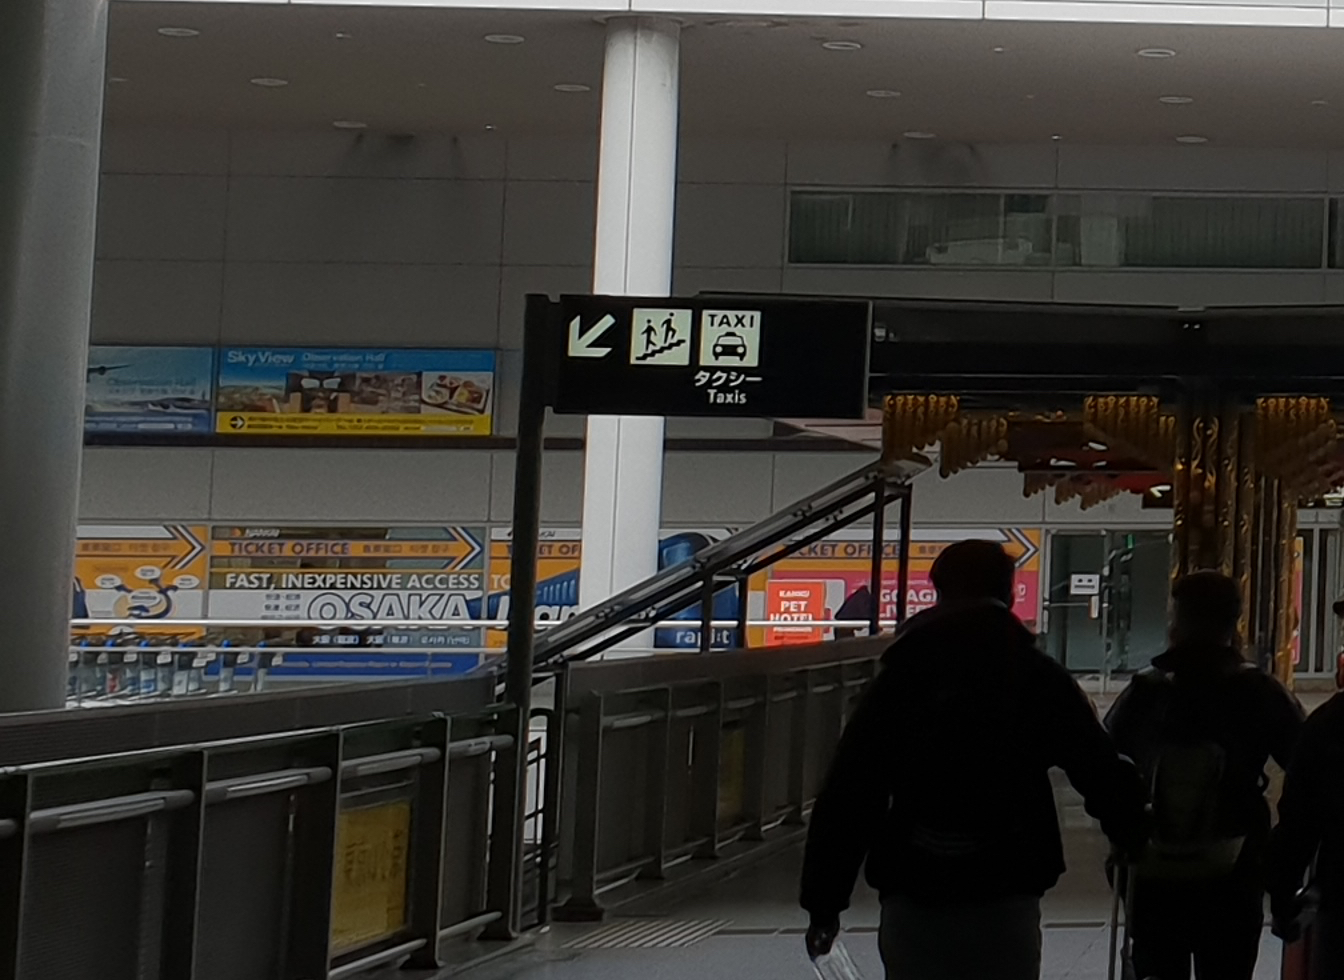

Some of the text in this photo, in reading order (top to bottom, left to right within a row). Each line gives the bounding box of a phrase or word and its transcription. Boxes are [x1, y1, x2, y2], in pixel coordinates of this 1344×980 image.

[708, 314, 754, 328] TAXI
[694, 371, 763, 386] タクシー
[707, 389, 747, 404] Taxis
[229, 542, 285, 554] TICKET
[292, 542, 349, 554] OFFICE
[225, 573, 479, 590] FAST, INEXPENSIVE ACCESS
[308, 592, 473, 630] OSAKA
[780, 601, 808, 612] PET
